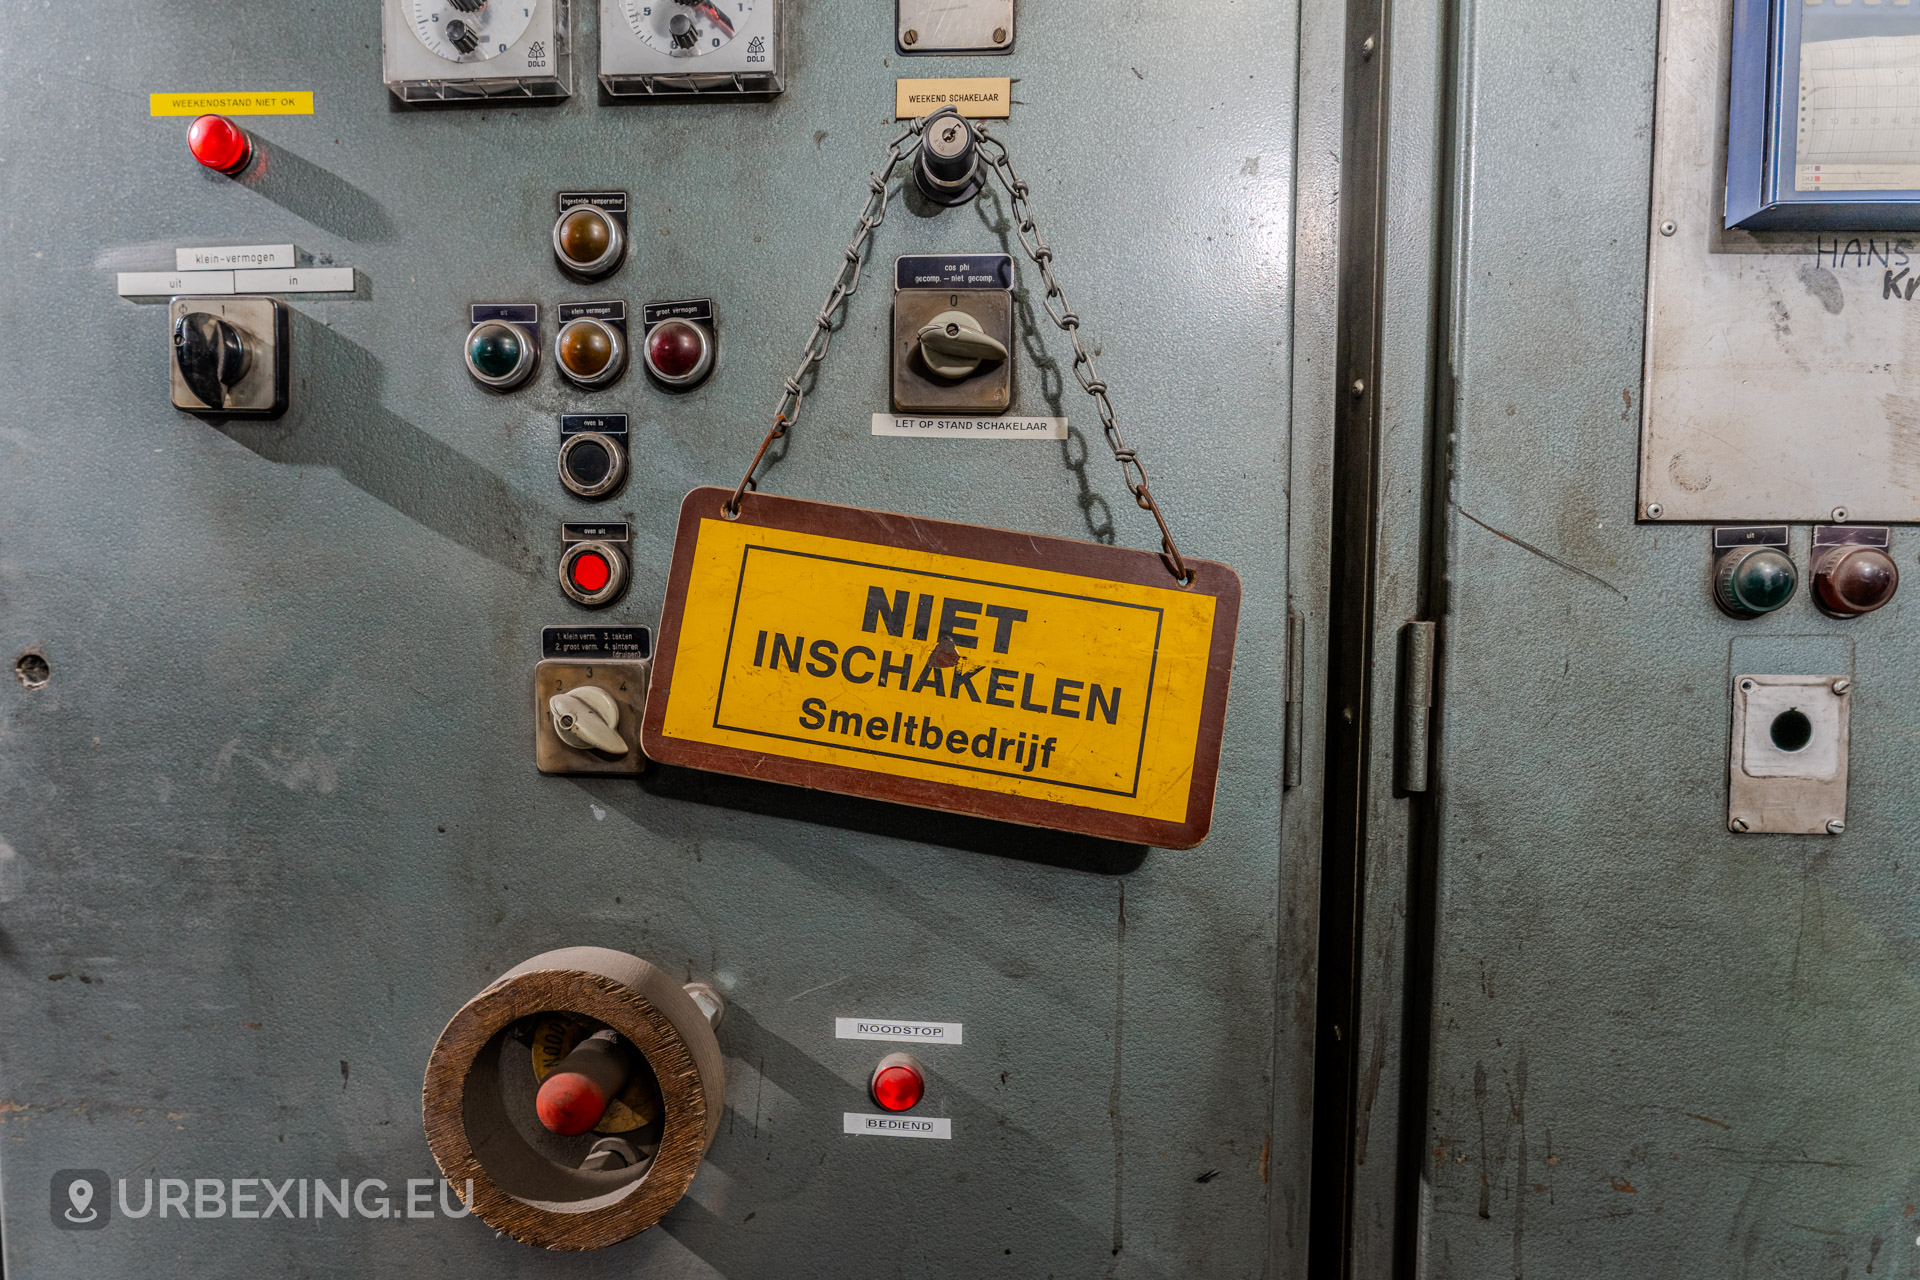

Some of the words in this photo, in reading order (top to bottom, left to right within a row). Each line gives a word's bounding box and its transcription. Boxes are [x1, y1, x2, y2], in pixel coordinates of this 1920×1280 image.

[643, 7, 651, 16] 5
[431, 13, 439, 22] 5
[712, 38, 720, 47] 0
[172, 98, 252, 108] WEEKENDSTAND
[255, 98, 276, 107] NIET
[281, 97, 296, 106] OK
[908, 95, 947, 103] WEEKEND
[949, 94, 999, 102] SCHAKELAAR
[1816, 235, 1914, 269] HANS
[196, 252, 275, 268] klein-vermogen
[959, 263, 970, 273] phi
[169, 278, 182, 288] uit
[289, 275, 298, 285] in
[914, 274, 942, 283] gecomp.
[951, 274, 964, 282] niet
[968, 275, 995, 284] gecomp.
[950, 294, 958, 307] 0
[586, 307, 611, 315] vermogen
[672, 306, 698, 315] vermogen
[904, 341, 909, 353] 1
[895, 419, 915, 428] LET
[919, 420, 934, 429] OP
[937, 421, 973, 430] STAND
[976, 421, 1048, 431] SCHAKELAAR
[861, 585, 1029, 655] NIET
[563, 632, 579, 640] klein
[604, 632, 610, 640] 3.
[563, 643, 580, 652] groot
[586, 666, 593, 679] 3
[752, 629, 1122, 726] INSCHAKELEN
[555, 679, 562, 691] 2
[619, 681, 627, 692] 4
[798, 697, 1057, 773] Smeltbedrijf
[859, 1024, 942, 1036] NOODSTOP
[868, 1119, 932, 1131] BEDIEND
